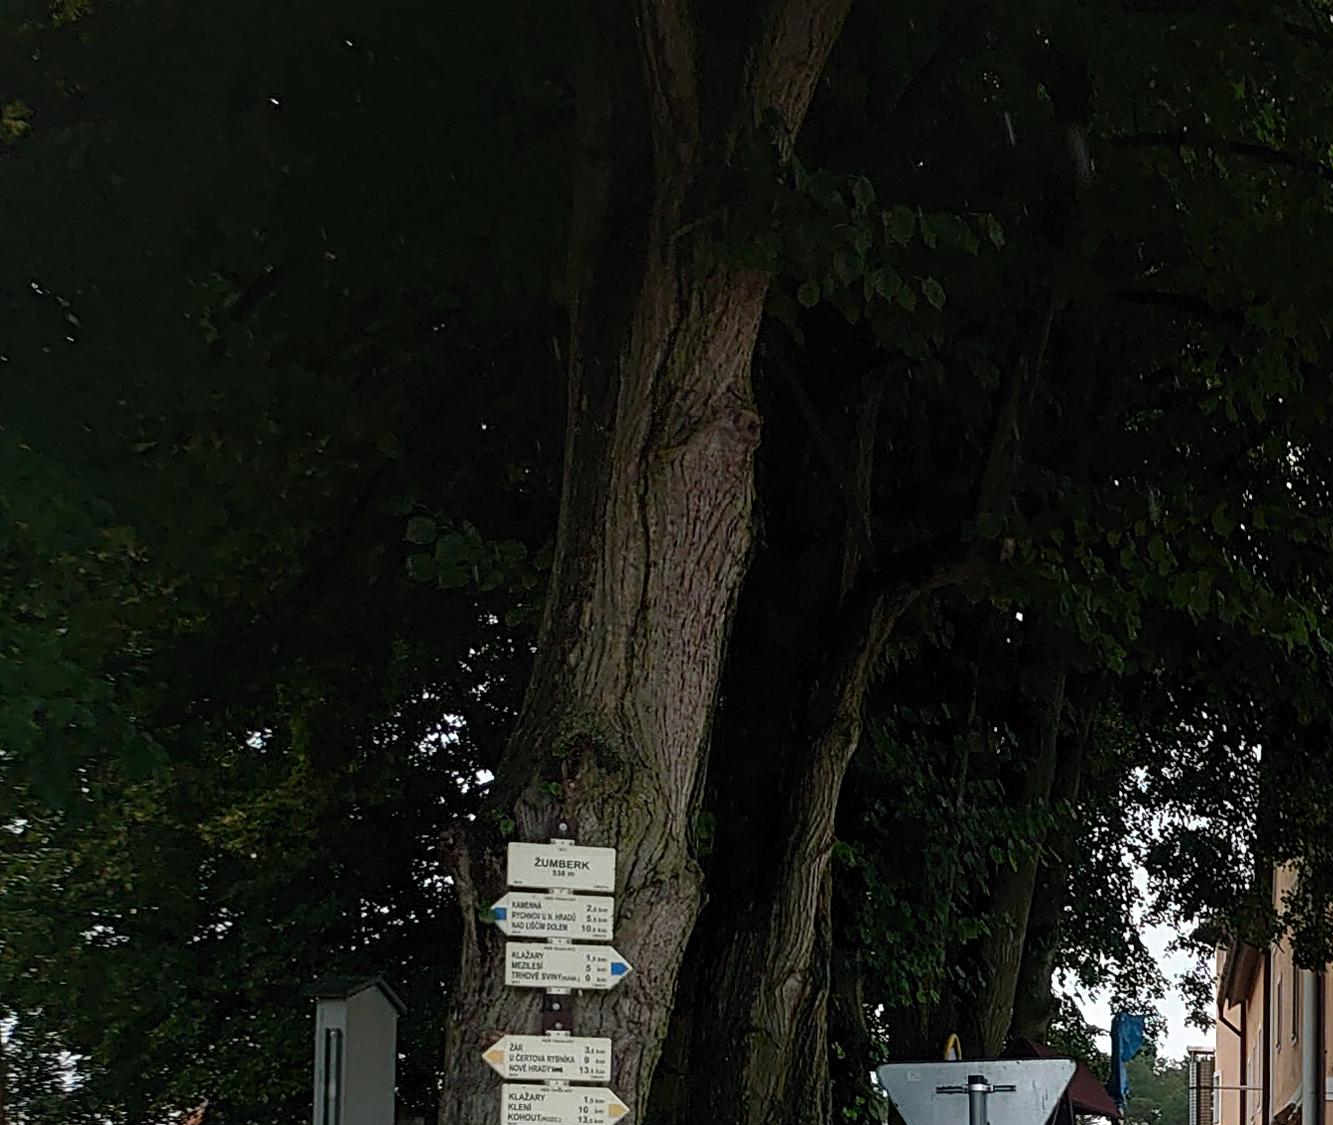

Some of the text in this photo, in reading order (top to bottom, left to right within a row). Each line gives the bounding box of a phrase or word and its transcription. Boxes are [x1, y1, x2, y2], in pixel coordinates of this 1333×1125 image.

[534, 857, 590, 870] ŽUMBERK
[547, 923, 568, 931] DOLEM
[512, 950, 544, 959] KLAŽARY
[512, 971, 539, 980] TRHOVÉ
[509, 1043, 523, 1052] ŽÁR
[516, 1054, 545, 1062] ČERTOVA
[509, 1064, 527, 1072] NOVÉ
[509, 1092, 545, 1101] KLAŽARY
[508, 1103, 532, 1111] KLENÍ
